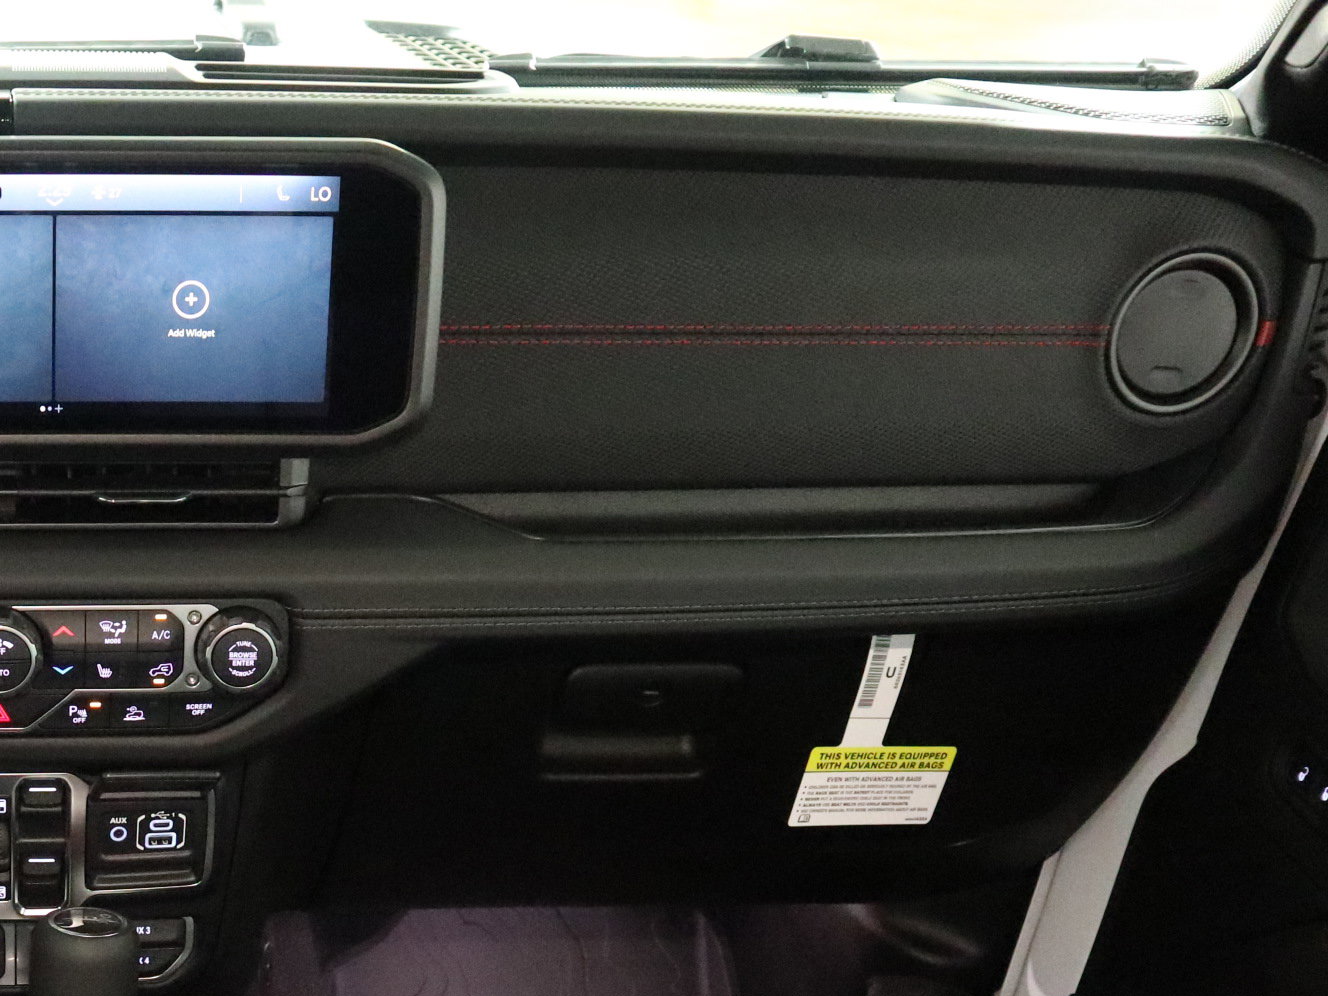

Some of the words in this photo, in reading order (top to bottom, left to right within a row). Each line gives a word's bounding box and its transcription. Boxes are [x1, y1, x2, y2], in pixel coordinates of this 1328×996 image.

[310, 186, 332, 202] LO
[167, 329, 184, 338] Add
[185, 329, 216, 339] Widget
[152, 630, 171, 640] A/C
[844, 752, 885, 760] VEHICLE
[899, 752, 948, 760] EQUIPPED
